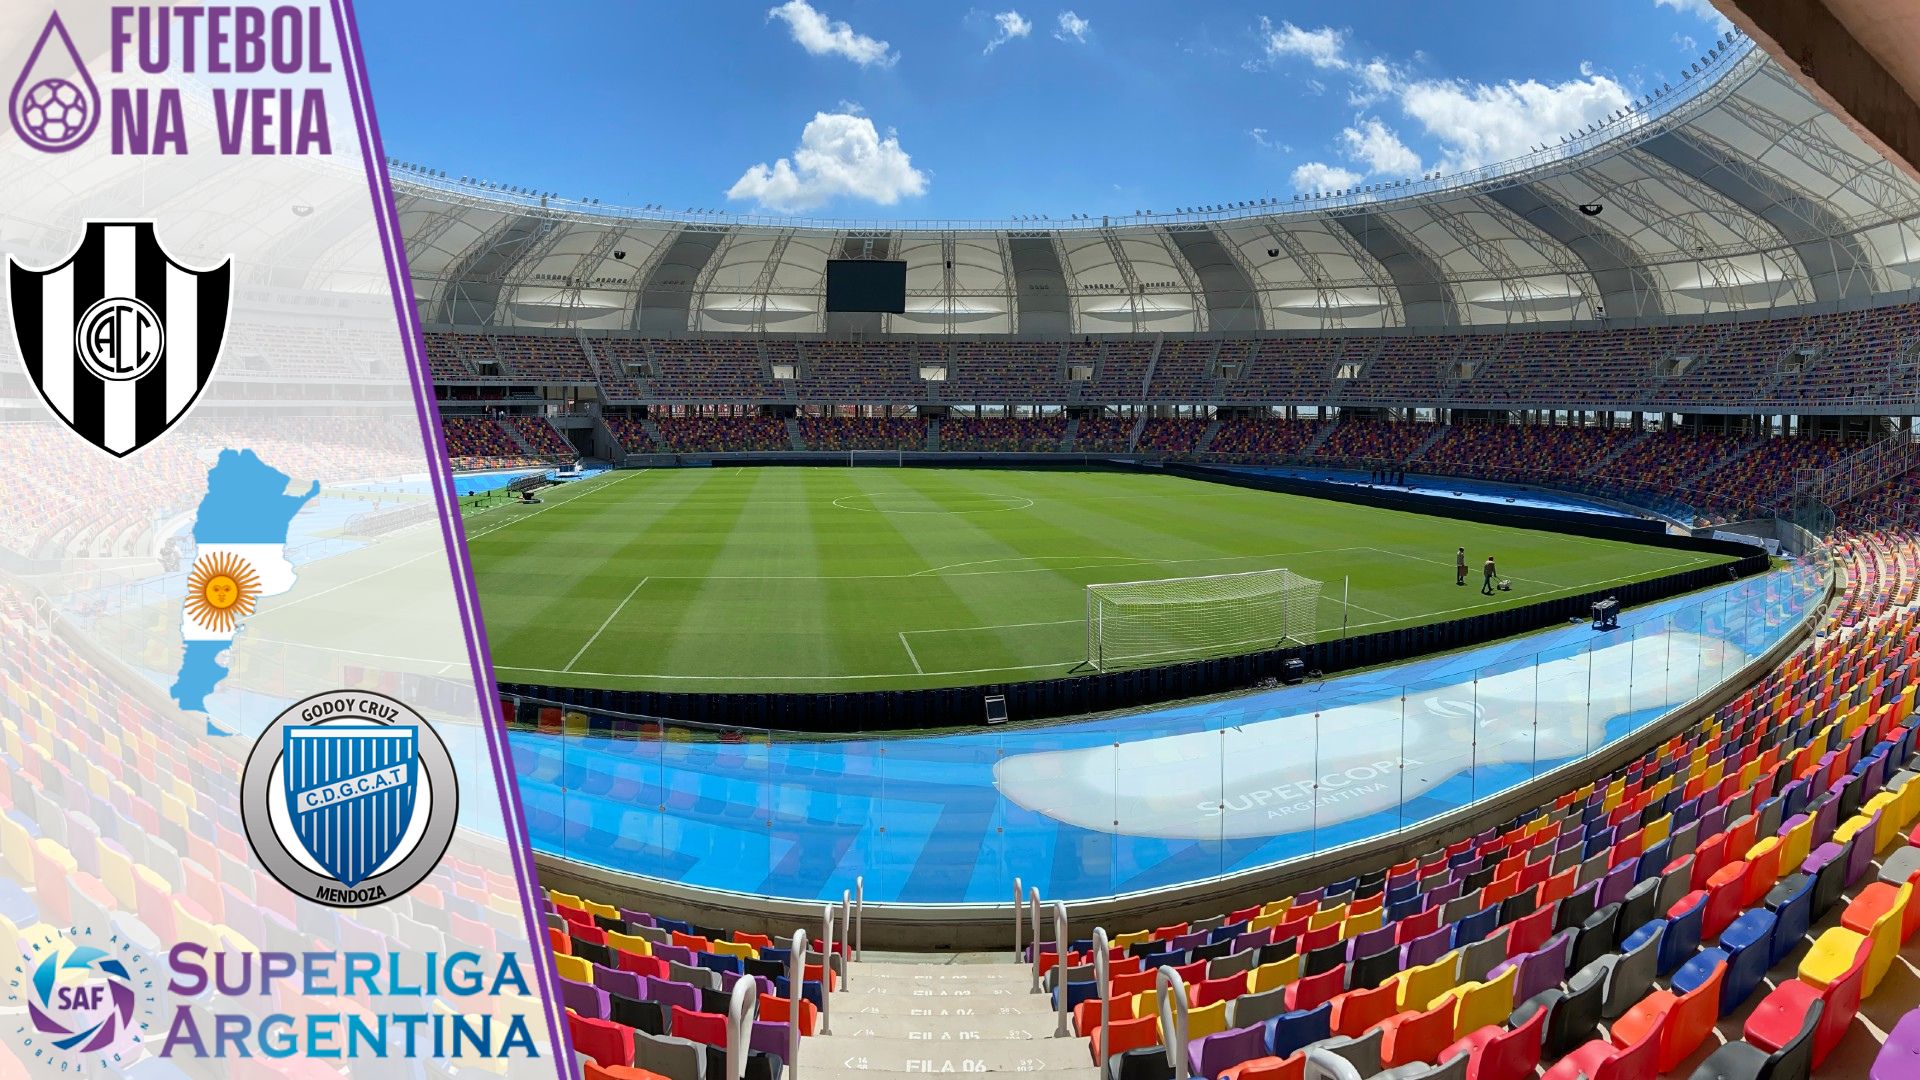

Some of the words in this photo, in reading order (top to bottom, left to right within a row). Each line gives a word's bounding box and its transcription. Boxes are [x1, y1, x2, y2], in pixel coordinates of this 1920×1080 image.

[1196, 755, 1424, 817] SUPERCOPA
[1267, 782, 1389, 820] ARGENTINA
[906, 1059, 955, 1073] FILA
[962, 1059, 987, 1073] 06
